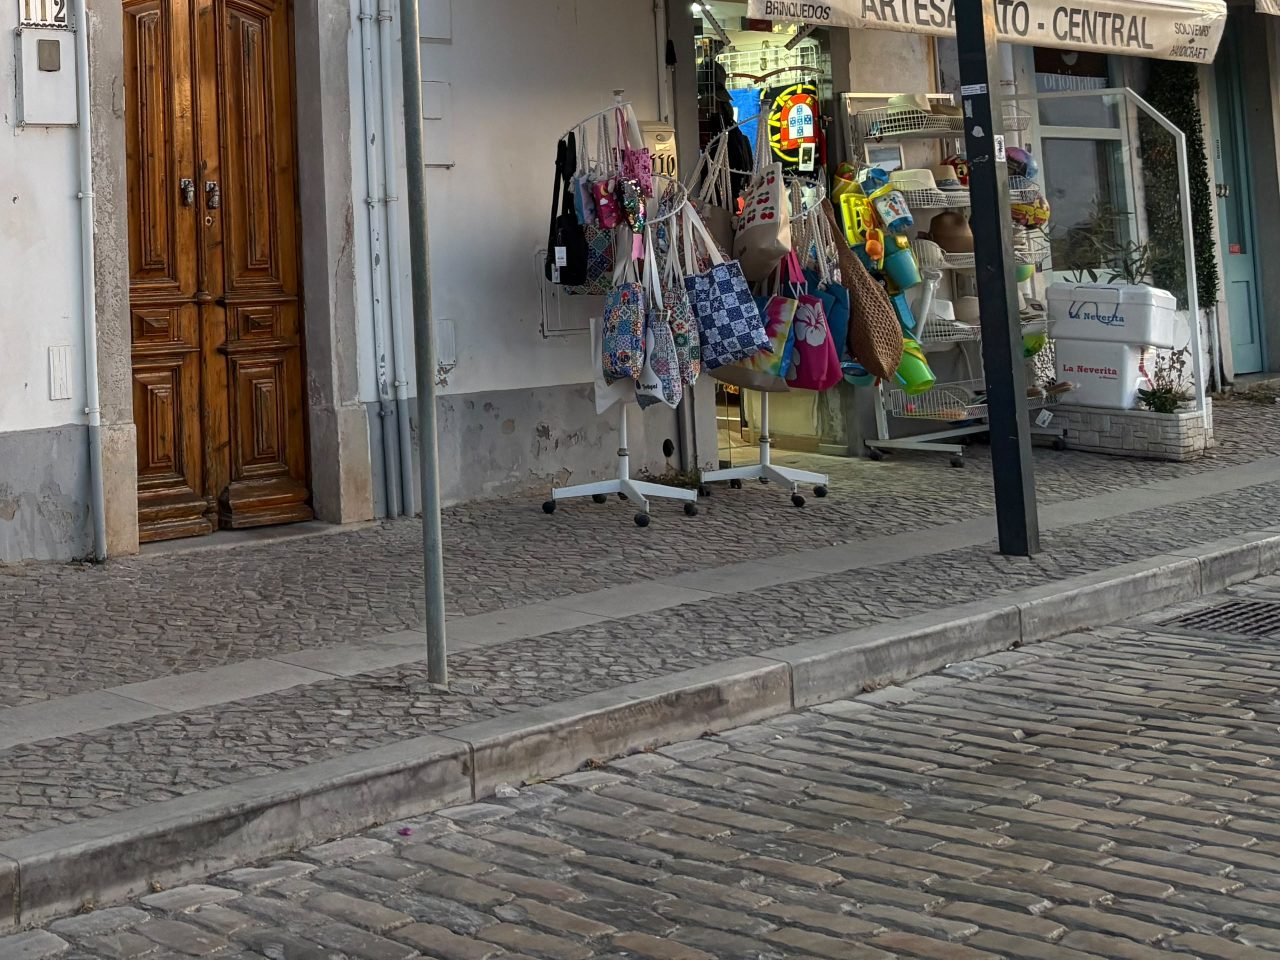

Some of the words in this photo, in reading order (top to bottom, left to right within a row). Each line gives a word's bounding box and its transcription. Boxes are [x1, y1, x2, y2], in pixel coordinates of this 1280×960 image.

[765, 0, 831, 20] BRINQUEDOS
[1053, 6, 1154, 50] CENTRAL
[650, 153, 676, 177] 110
[1077, 365, 1117, 375] Neverita
